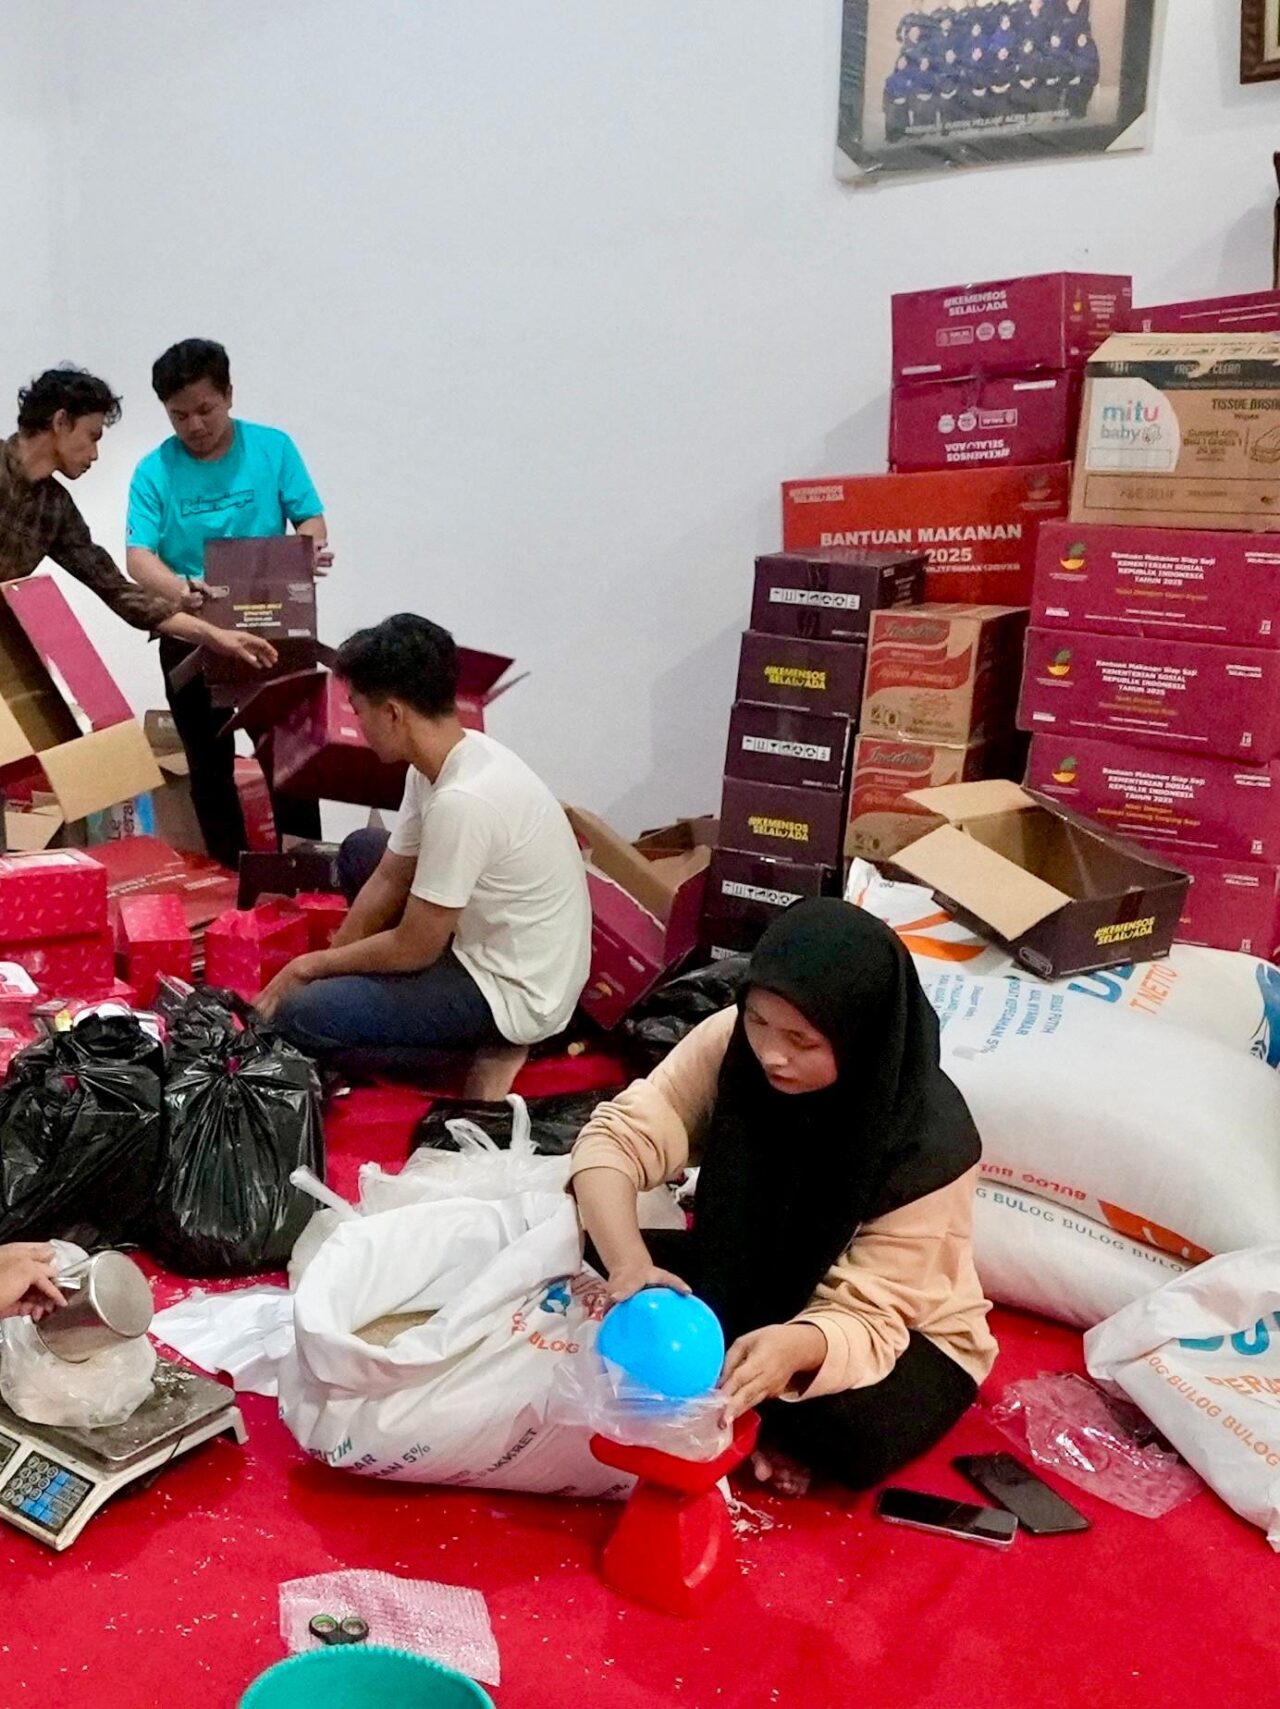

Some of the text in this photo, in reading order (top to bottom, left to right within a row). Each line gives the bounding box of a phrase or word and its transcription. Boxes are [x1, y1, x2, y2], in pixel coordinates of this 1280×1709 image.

[1102, 400, 1160, 421] mitu
[1100, 424, 1141, 443] baby
[820, 524, 1022, 547] BANTUAN MAKANAN
[924, 546, 973, 564] 2025
[1022, 1173, 1087, 1201] BULOG
[993, 1191, 1055, 1222] BULOG
[1061, 1218, 1125, 1251] BULOG
[1131, 1248, 1190, 1273] BULO
[1167, 1375, 1222, 1418] BULOG
[1222, 1415, 1280, 1467] BULOG
[402, 1442, 432, 1464] 5%
